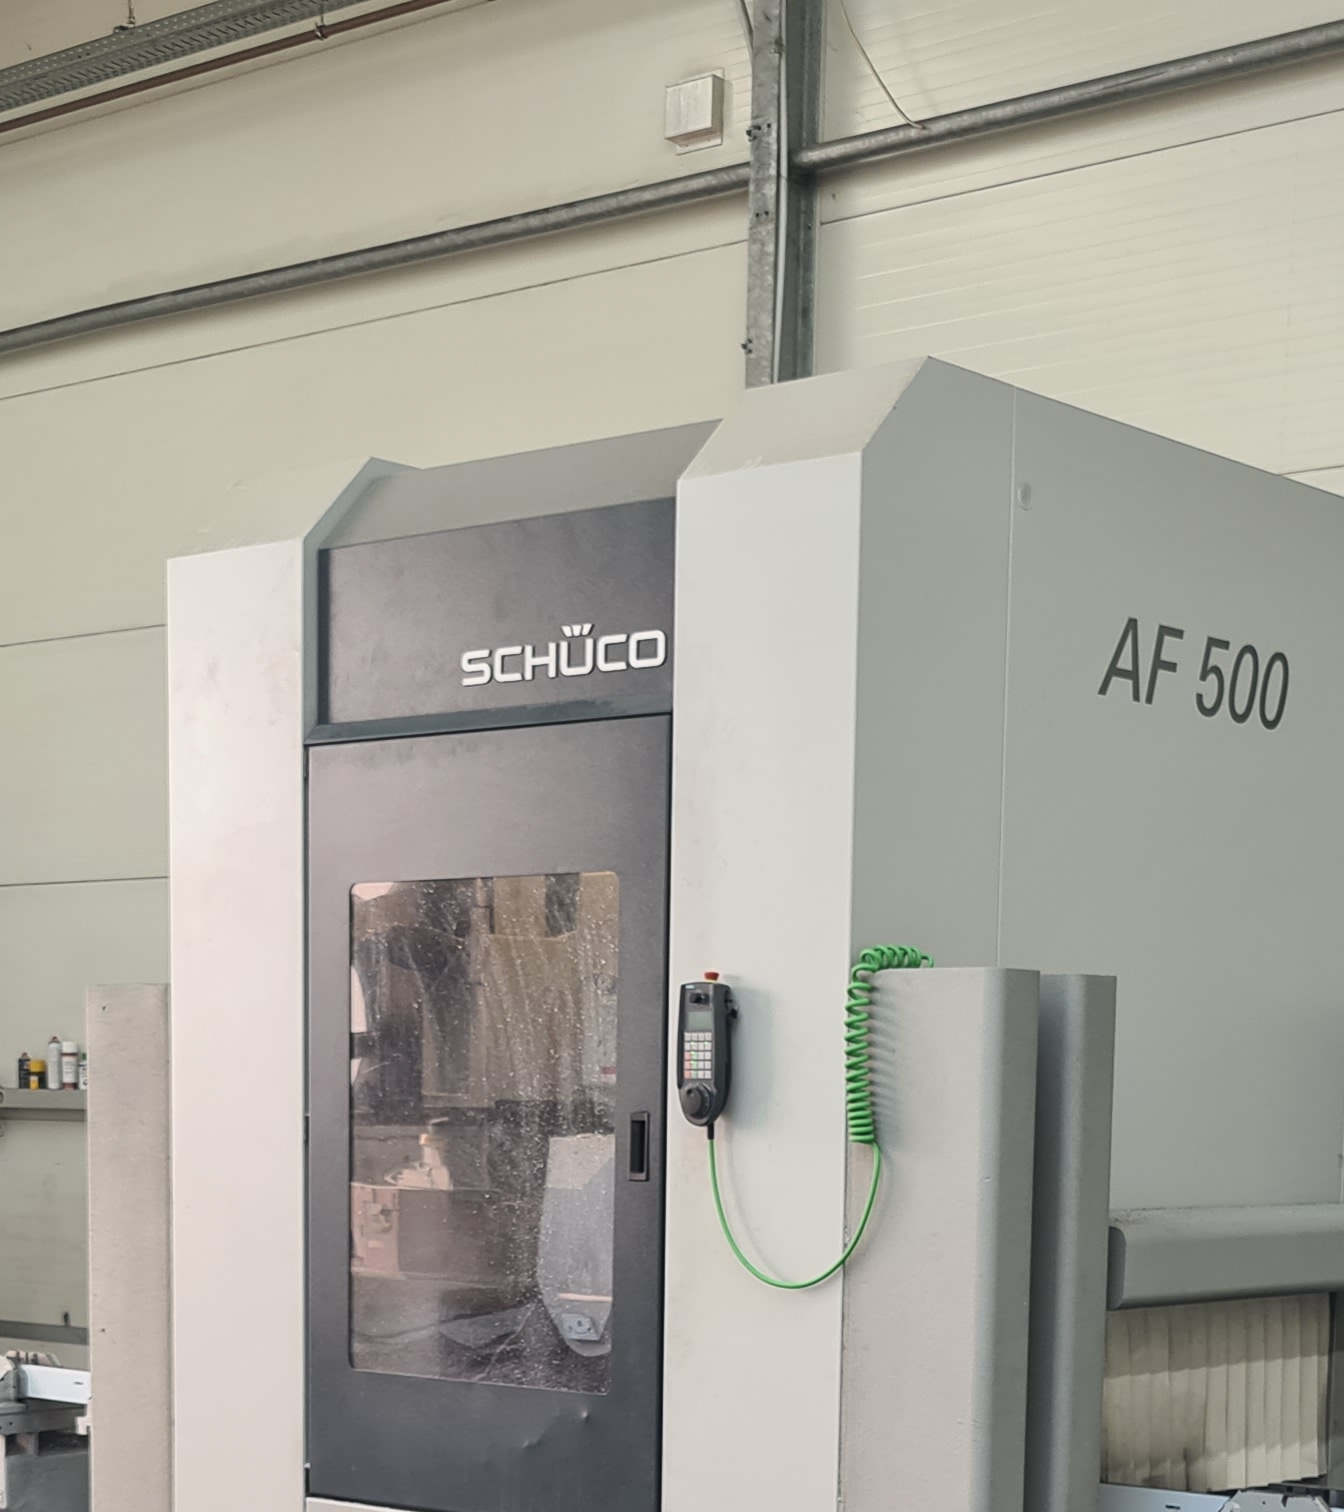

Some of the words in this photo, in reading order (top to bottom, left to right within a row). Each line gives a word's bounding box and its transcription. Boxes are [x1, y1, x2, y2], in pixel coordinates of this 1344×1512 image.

[460, 622, 668, 688] SCHÜCO
[1097, 615, 1186, 707] AF
[1195, 634, 1291, 732] 500
